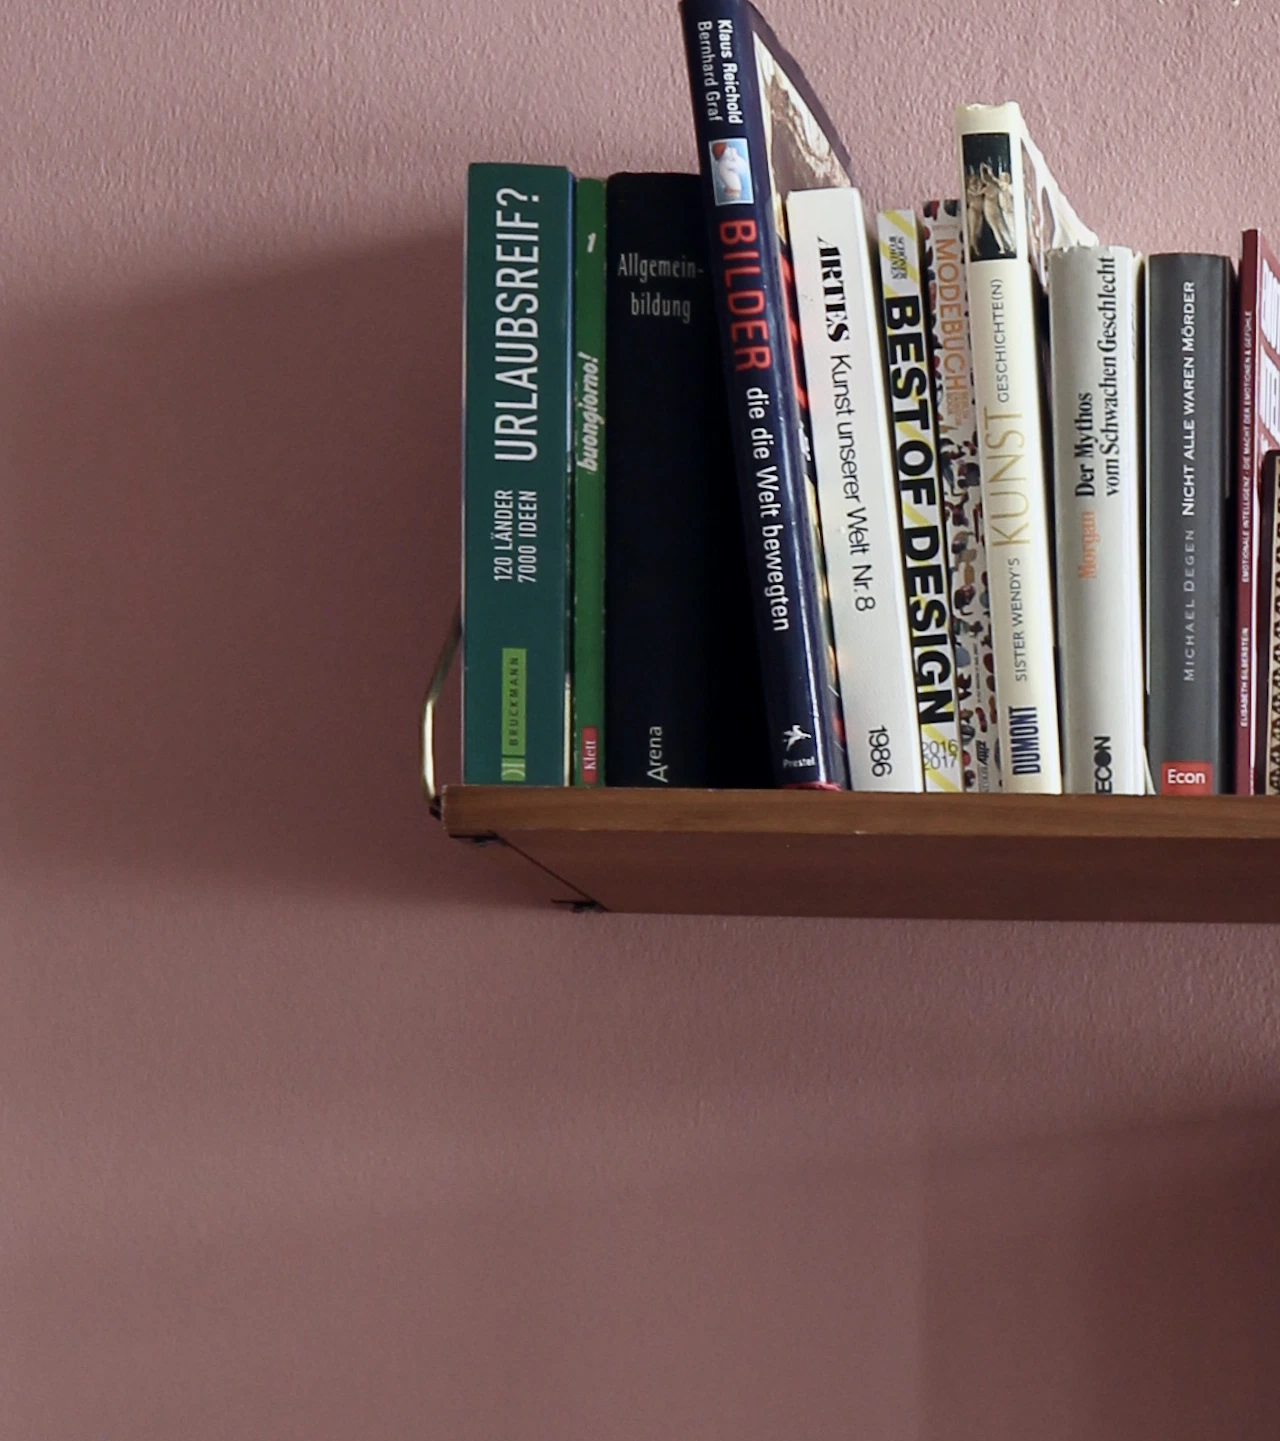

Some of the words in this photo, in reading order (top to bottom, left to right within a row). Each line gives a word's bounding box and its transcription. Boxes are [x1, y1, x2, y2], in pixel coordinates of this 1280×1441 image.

[697, 21, 719, 88] Bernhard
[717, 19, 734, 60] Klaus
[705, 89, 723, 122] Graf
[722, 61, 743, 125] Reichold
[617, 253, 704, 283] Allgemein-
[720, 219, 772, 371] BILDER
[817, 236, 851, 343] ARTES
[494, 187, 539, 461] URLAUBSREIF?
[631, 292, 691, 323] bildung
[935, 238, 968, 391] MODEBUCH
[1097, 257, 1117, 353] Geschlecht
[1181, 281, 1195, 352] MÖRDER
[885, 295, 930, 430] BEST
[990, 278, 1010, 403] GESCHICHTE(N)
[577, 351, 605, 473] buongiorno!
[746, 386, 769, 420] die
[830, 354, 856, 417] Kunst
[1099, 356, 1120, 455] Schwachen
[1182, 357, 1195, 415] WAREN
[751, 427, 775, 460] die
[1074, 392, 1099, 458] Mythos
[1183, 419, 1195, 460] ALLE
[755, 466, 780, 519] Welt
[836, 421, 861, 504] unserer
[896, 440, 936, 506] OF
[984, 407, 1030, 548] KUNST
[1075, 464, 1096, 498] Der
[1106, 460, 1120, 498] vom
[1182, 464, 1195, 516] NICHT
[491, 490, 513, 550] LÄNDER
[518, 491, 537, 537] IDEEN
[847, 508, 869, 556] Welt
[494, 557, 513, 581] 120
[518, 545, 537, 583] 7000
[1078, 511, 1100, 579] Morgan
[1182, 530, 1195, 592] DEGEN
[762, 524, 790, 632] bewegten
[852, 565, 871, 592] Nr.
[855, 596, 876, 612] 8
[1008, 557, 1024, 627] WENDY'S
[902, 525, 955, 725] DESIGN
[1183, 600, 1195, 682] MICHAEL
[1014, 629, 1028, 682] SISTER
[509, 657, 519, 746] BRUCKMANN
[1240, 679, 1249, 727] ELISABETH
[584, 741, 597, 770] Klett
[647, 725, 668, 783] Arena
[868, 725, 892, 777] 1986
[1008, 706, 1041, 776] DUMONT
[1094, 736, 1112, 793] ECON
[1167, 769, 1206, 785] Econ
